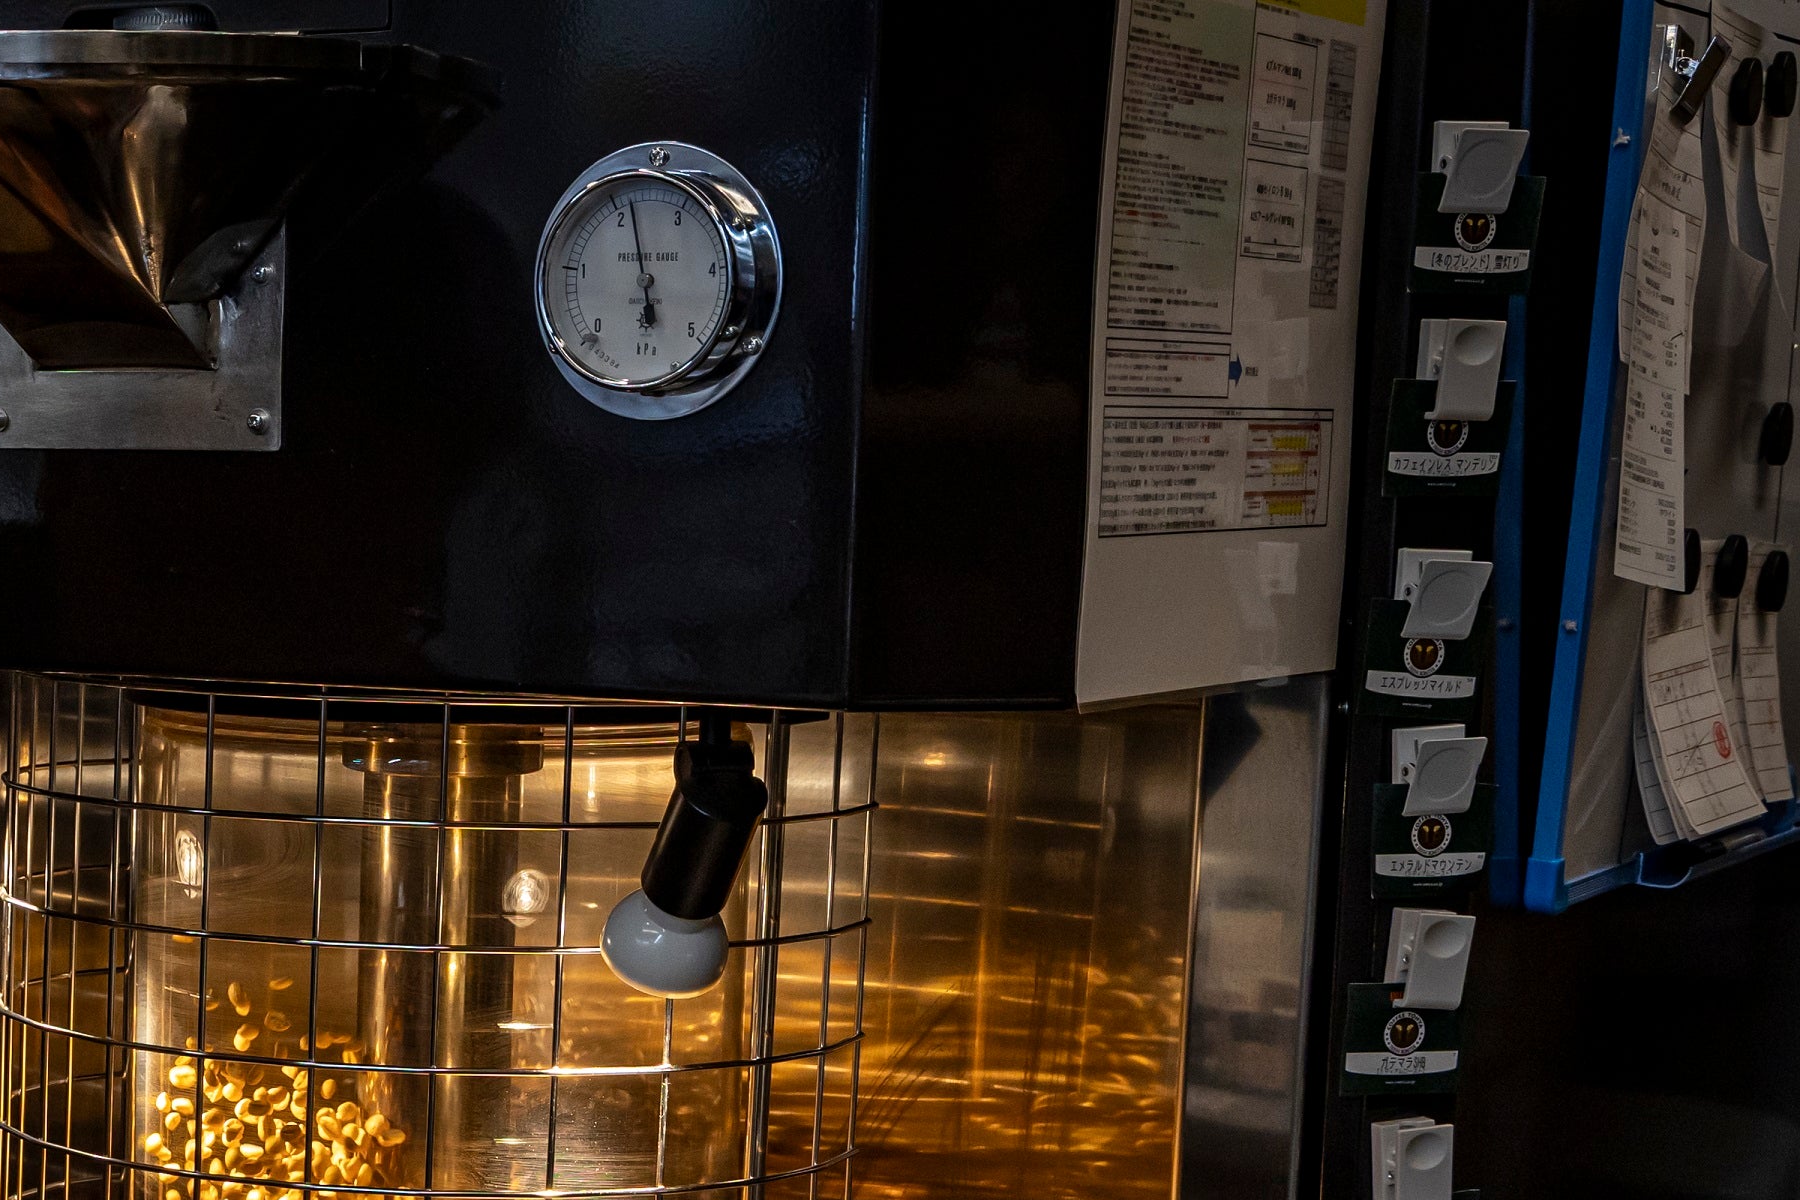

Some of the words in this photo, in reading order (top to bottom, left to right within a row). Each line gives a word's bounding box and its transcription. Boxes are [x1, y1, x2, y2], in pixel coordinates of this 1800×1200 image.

[617, 212, 625, 227] 2
[674, 211, 682, 226] 3
[617, 252, 652, 263] PRESSRE
[656, 252, 679, 262] GAUGE
[582, 263, 586, 279] 1
[708, 263, 717, 278] 4
[594, 318, 602, 334] 0
[687, 323, 696, 338] 5
[1394, 458, 1451, 472] カフェインレス
[1456, 457, 1497, 472] マンデリン
[1390, 858, 1473, 874] エメラルドマウンテン
